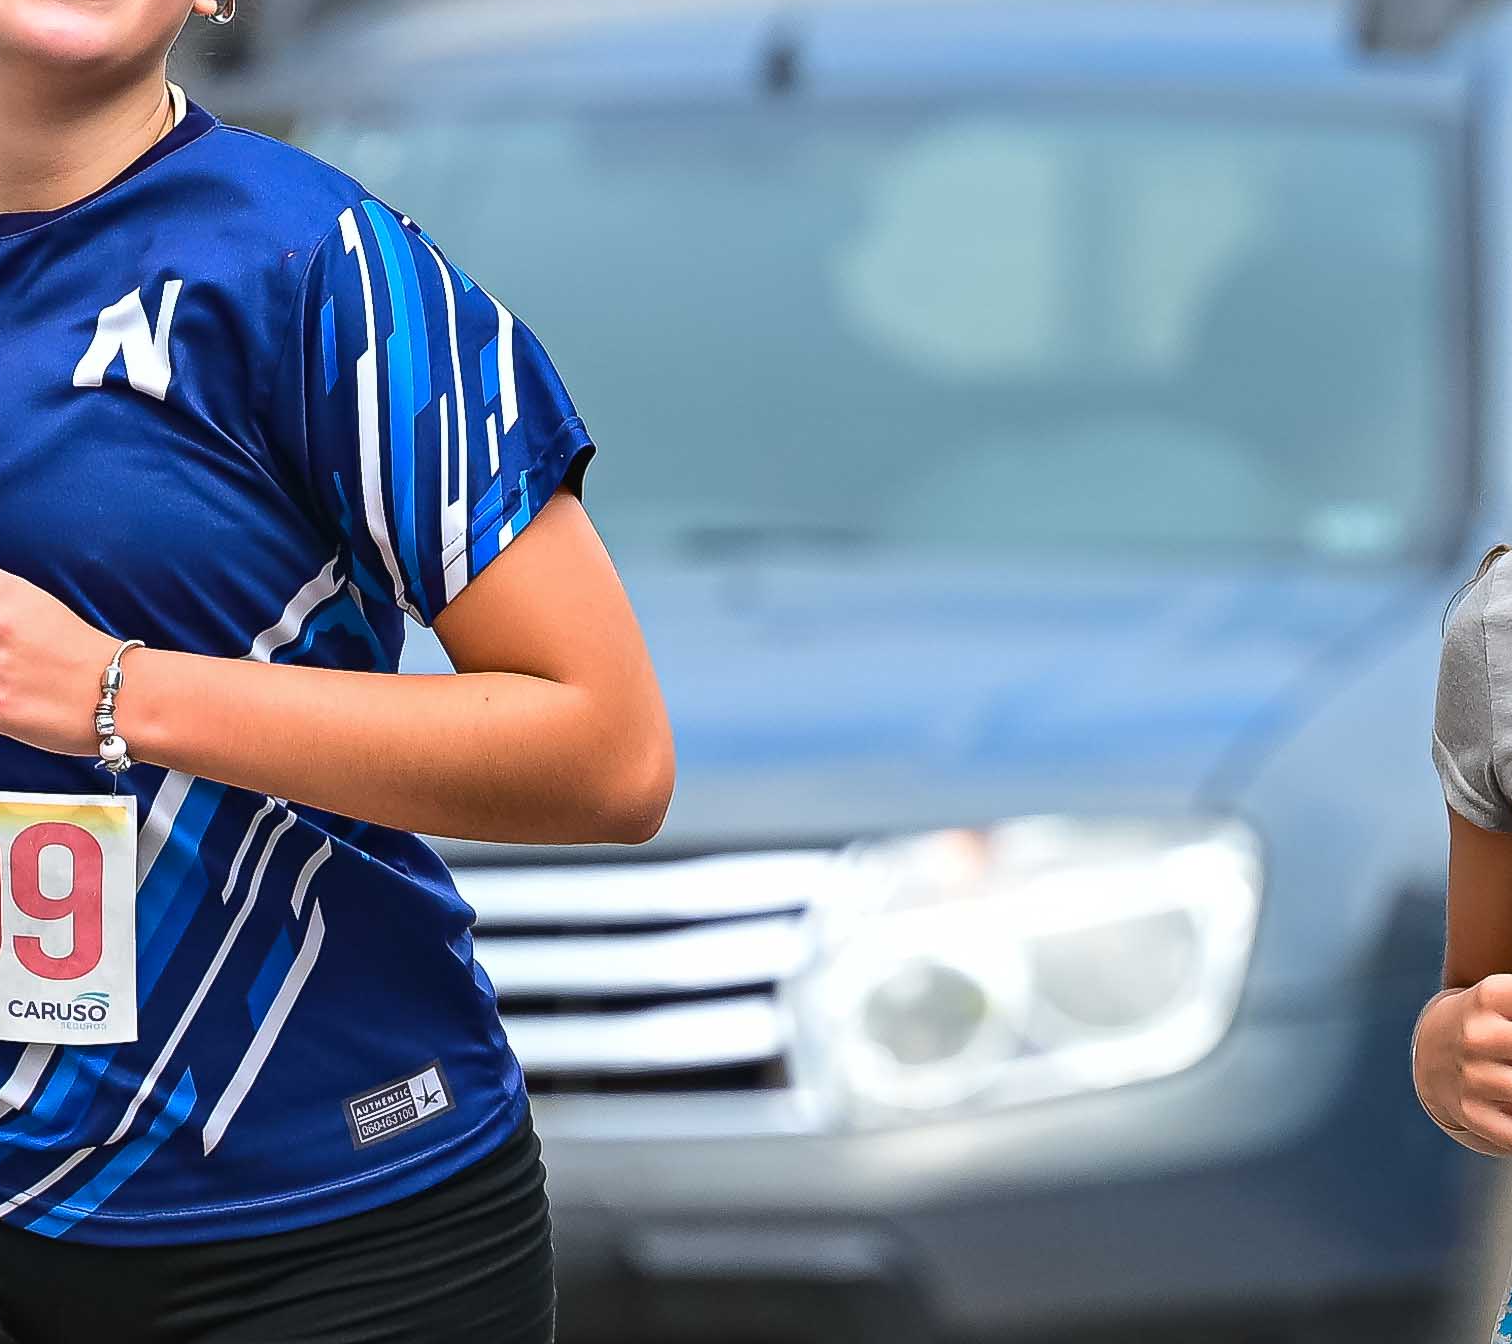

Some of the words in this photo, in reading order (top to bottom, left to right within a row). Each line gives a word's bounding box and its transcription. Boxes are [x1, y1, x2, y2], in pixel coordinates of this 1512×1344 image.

[72, 279, 184, 402] N
[8, 999, 107, 1022] CARUSO
[60, 1021, 108, 1031] SEGUROS
[355, 1087, 410, 1117] AUTHENTIC
